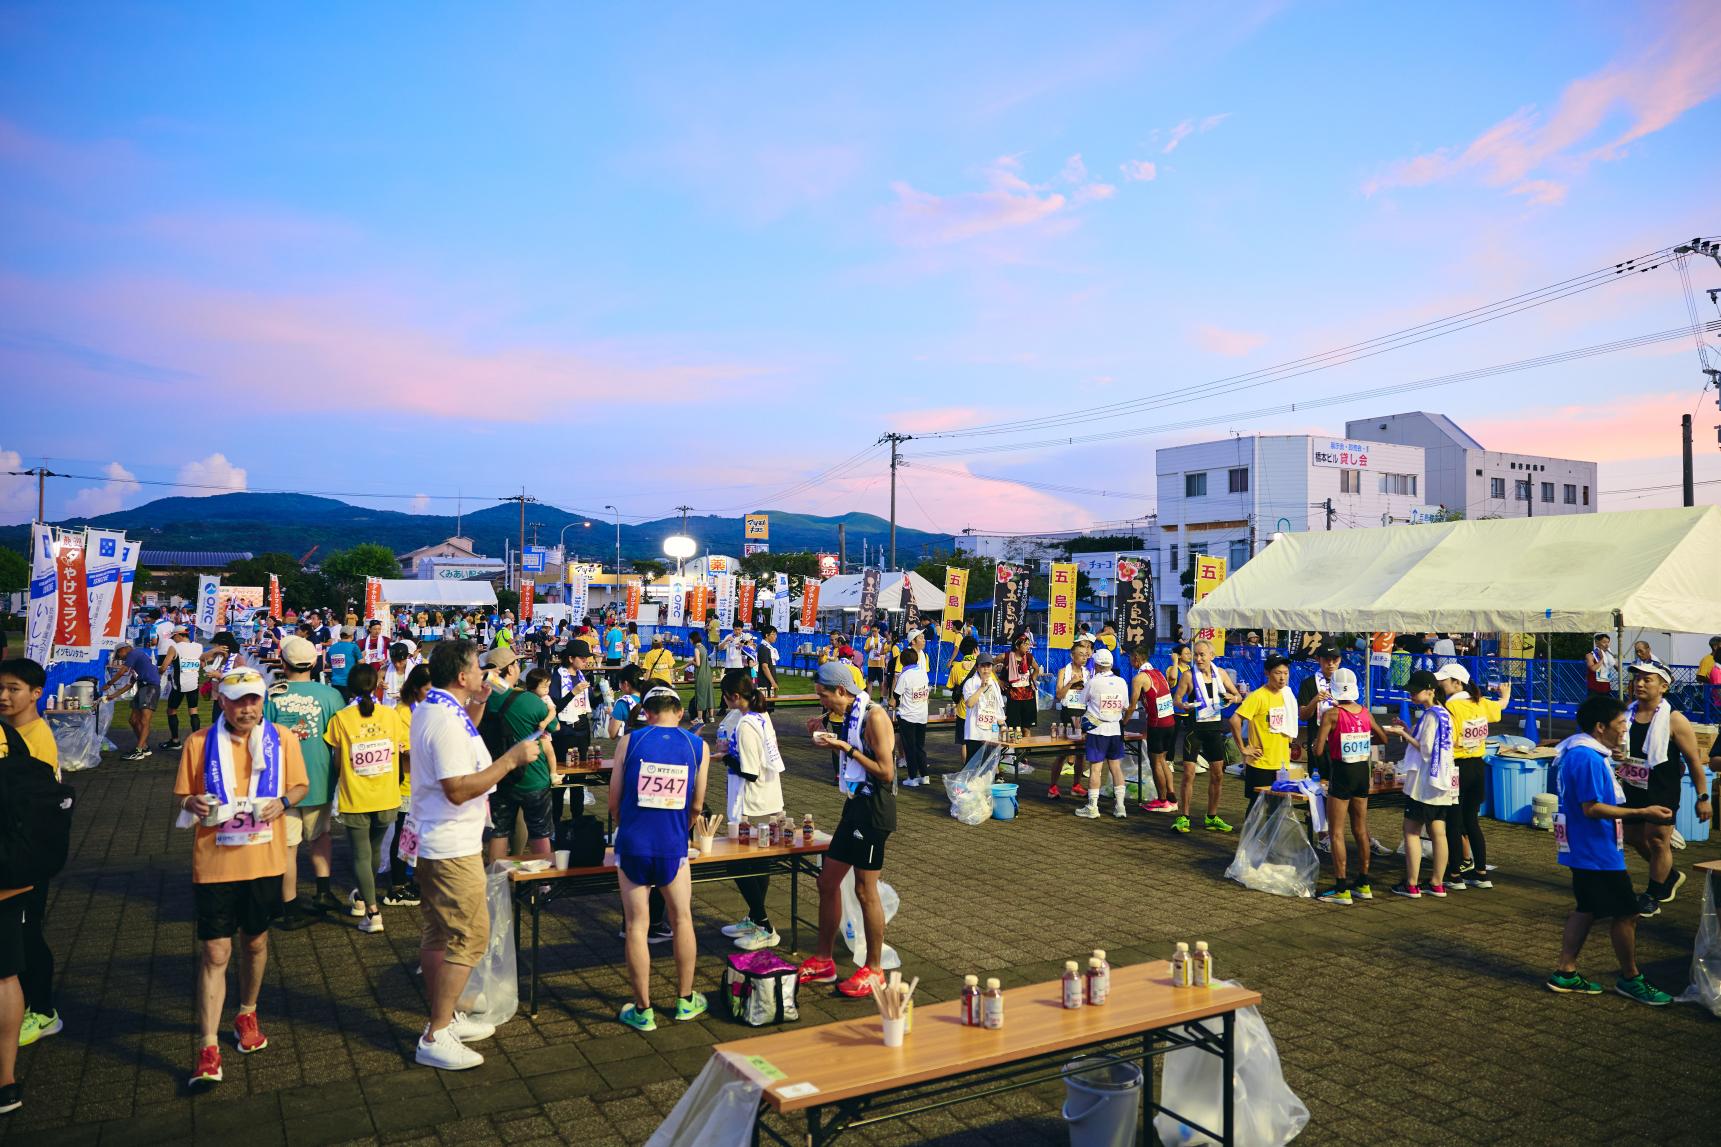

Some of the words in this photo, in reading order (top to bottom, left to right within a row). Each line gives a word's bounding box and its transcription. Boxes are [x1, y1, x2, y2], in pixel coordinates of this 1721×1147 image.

[710, 559, 725, 570] 薬
[204, 596, 216, 625] ORC
[673, 594, 682, 618] ORC
[1052, 570, 1069, 635] 五島豚
[1102, 700, 1122, 709] 7553
[1464, 724, 1488, 739] 8068
[1343, 740, 1369, 753] 6014
[354, 748, 390, 766] 8027
[640, 775, 686, 795] 7547
